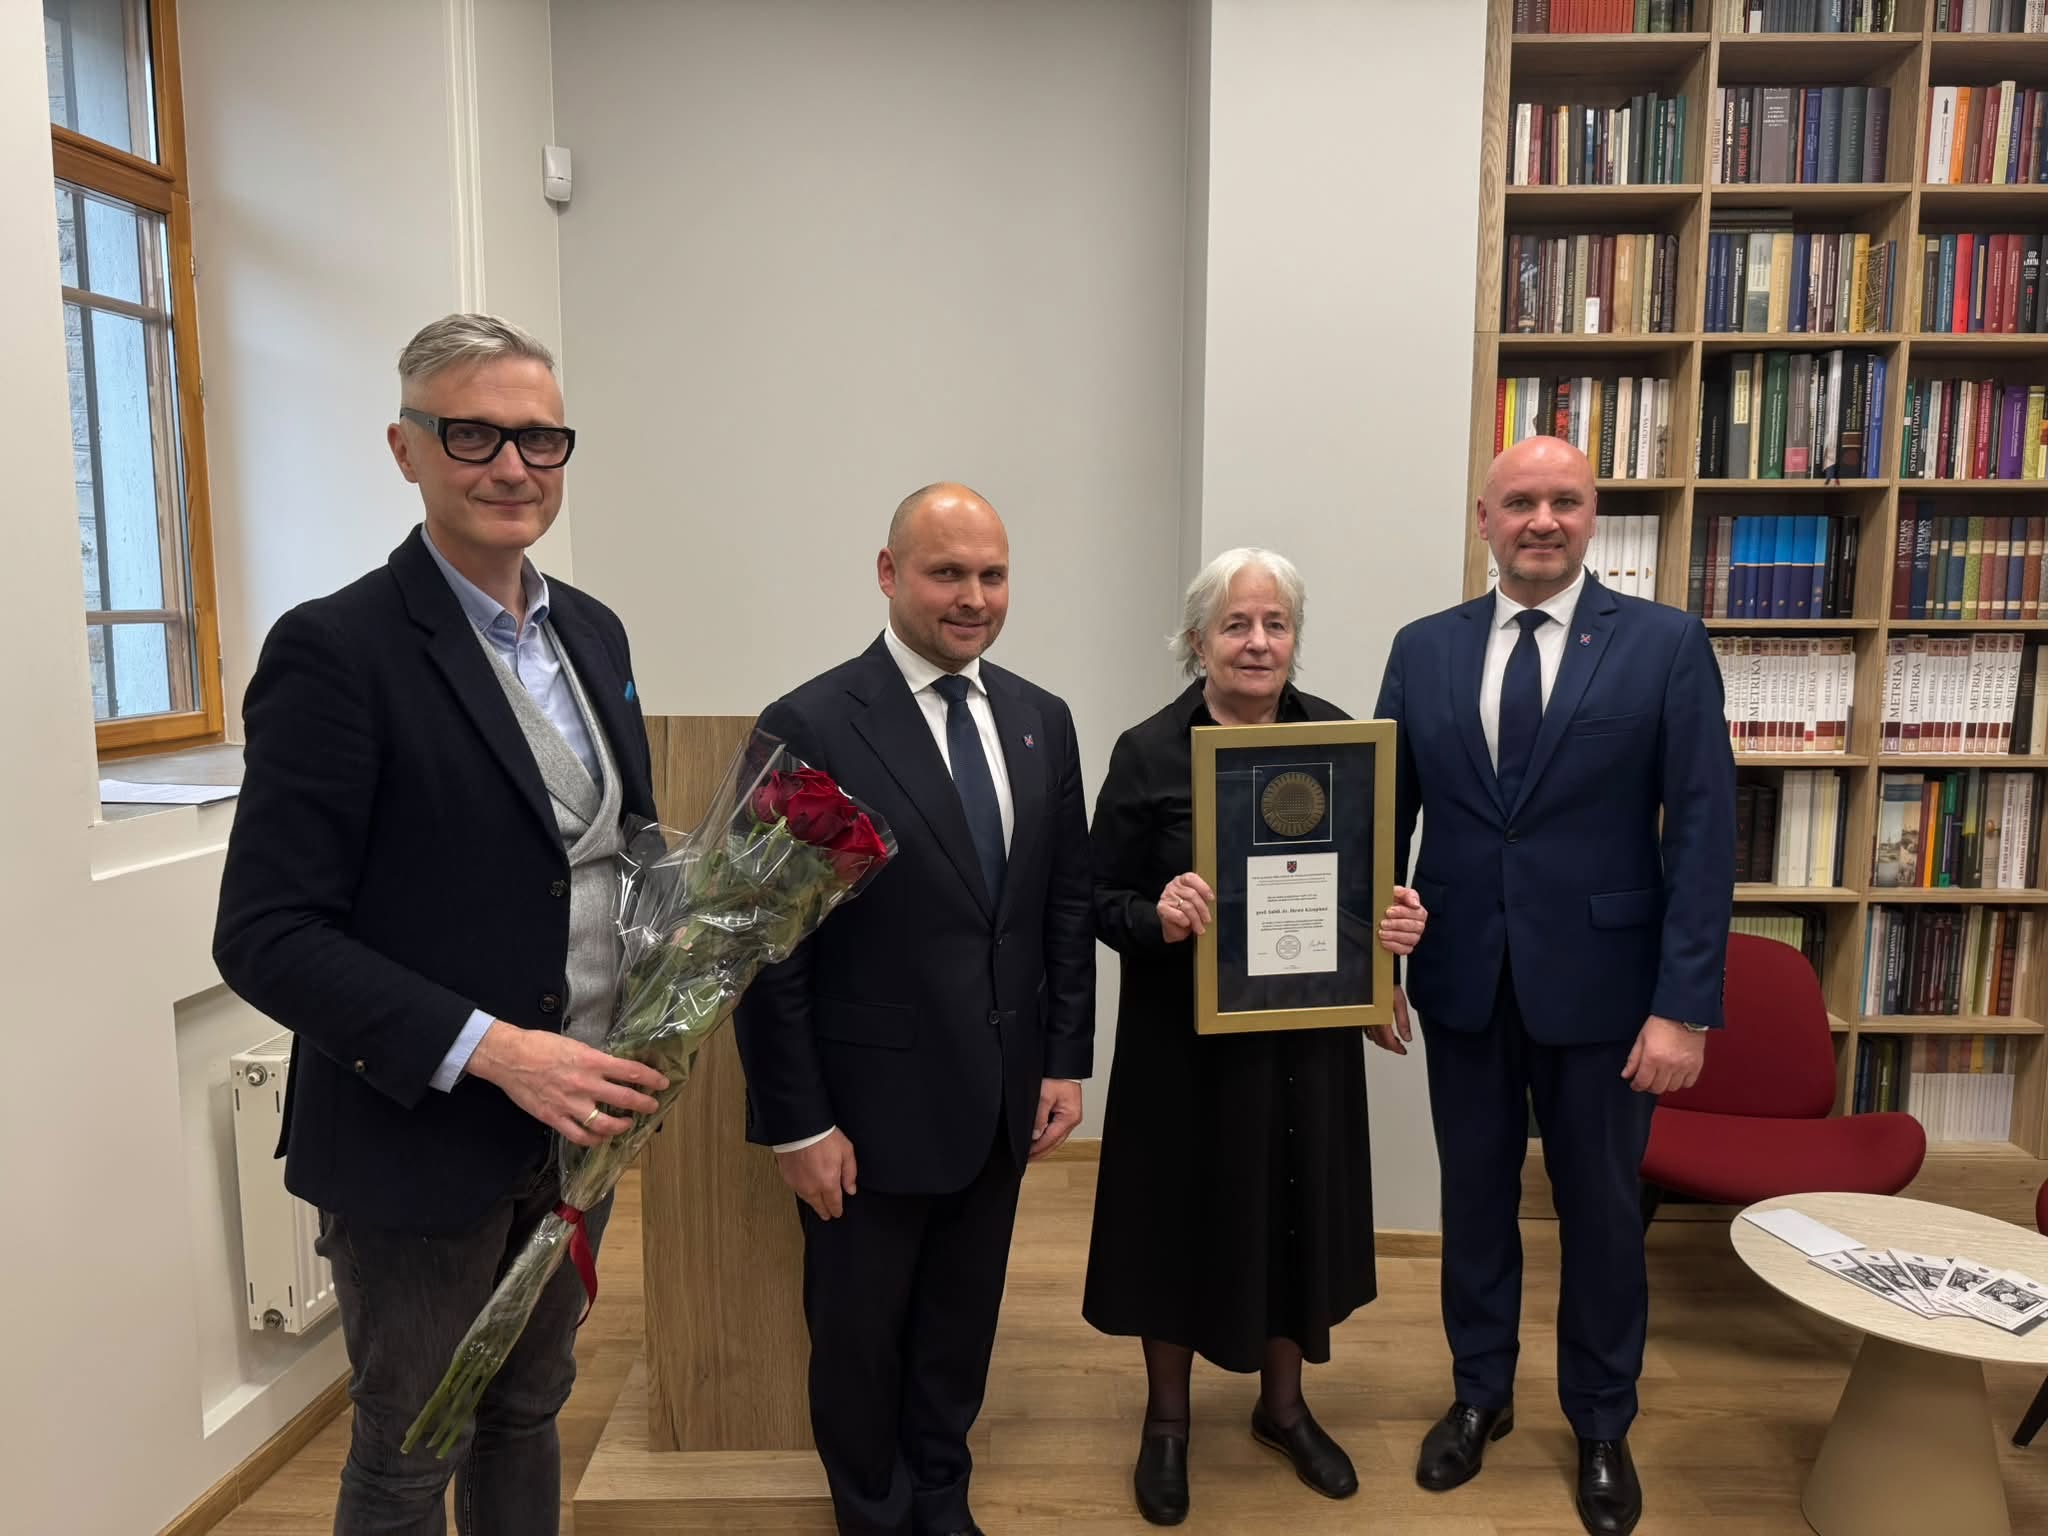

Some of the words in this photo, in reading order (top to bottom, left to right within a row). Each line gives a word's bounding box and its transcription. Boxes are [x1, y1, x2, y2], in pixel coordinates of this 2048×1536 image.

[1749, 659, 1760, 718] METRIKA
[1889, 659, 1904, 718] METRIKA
[1909, 662, 1921, 713] METRIKA
[1969, 662, 1983, 712] METRIKA
[1982, 664, 1994, 710] METRIKA
[1993, 665, 2006, 710] METRIKA
[2006, 664, 2019, 709] METRIKA
